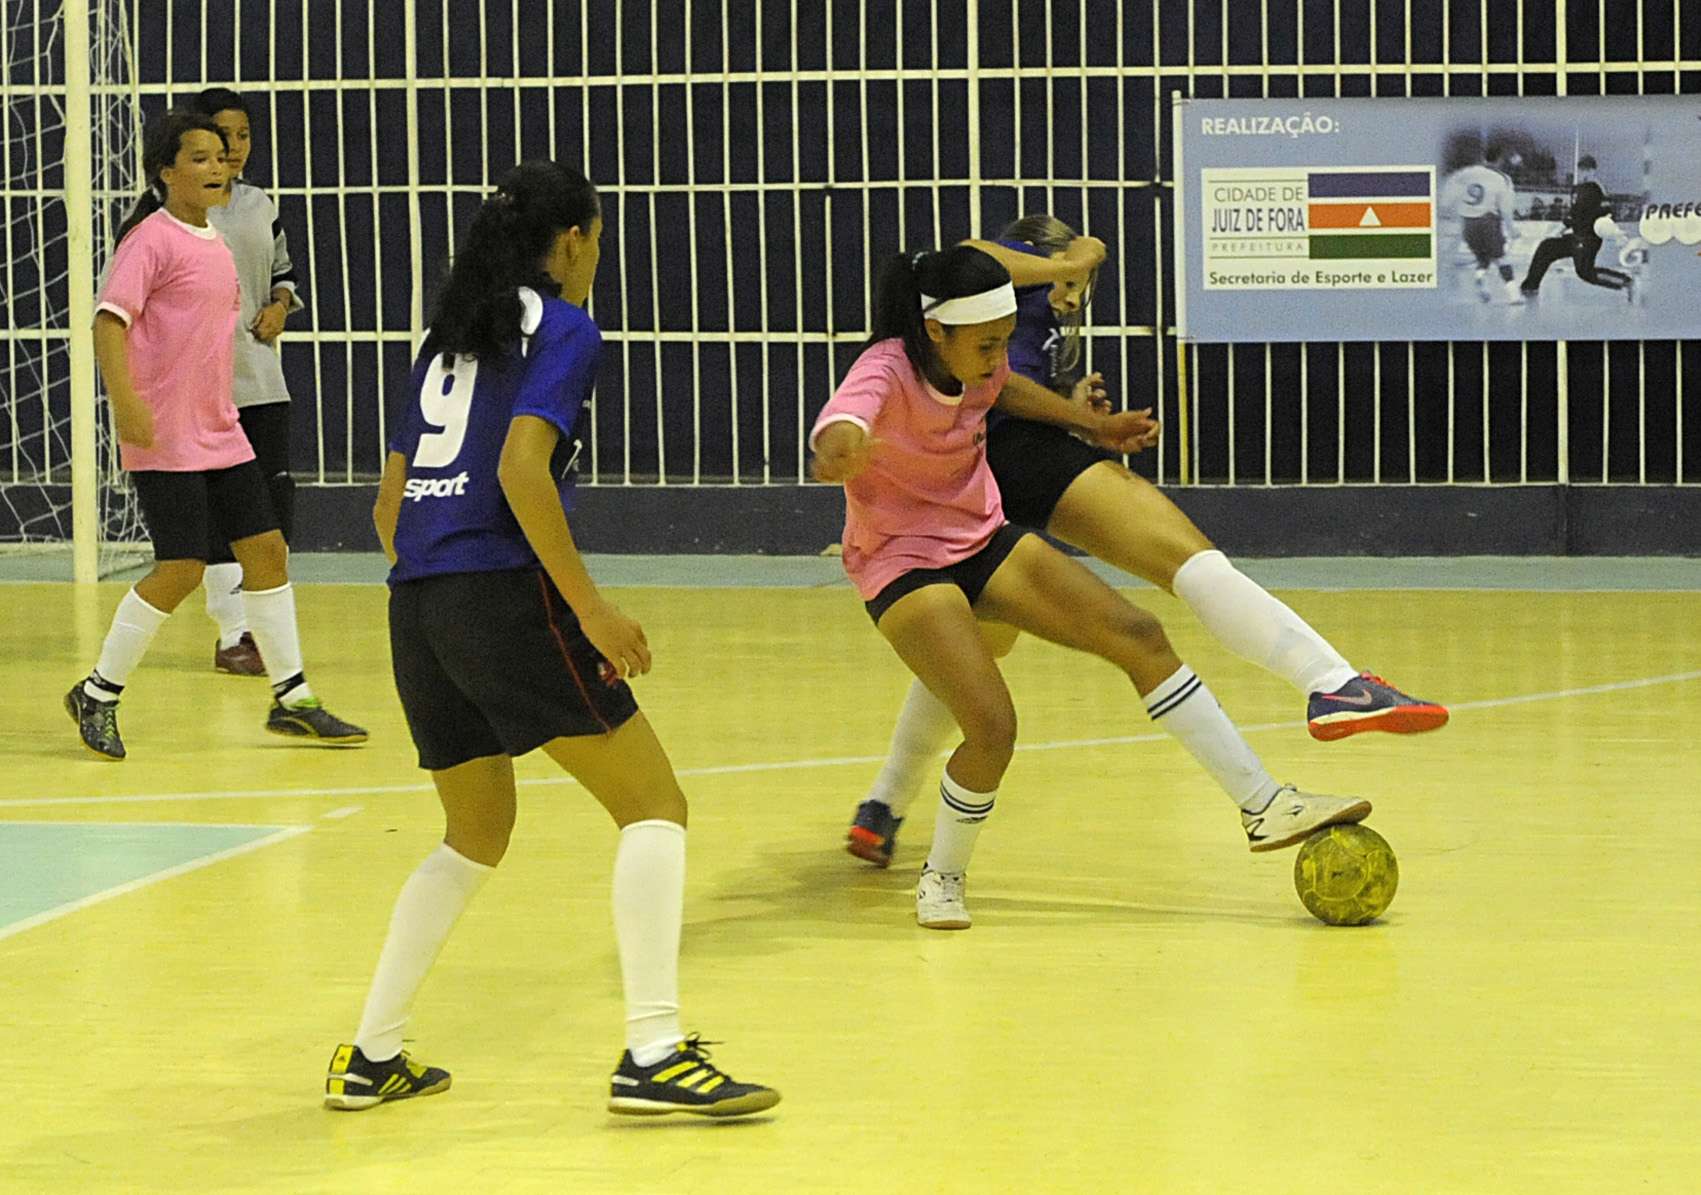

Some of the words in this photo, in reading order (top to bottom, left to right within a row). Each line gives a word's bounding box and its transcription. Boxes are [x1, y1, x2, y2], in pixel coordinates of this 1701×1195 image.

[1201, 112, 1340, 138] REALIZAÇÃO:
[1213, 187, 1276, 203] CIDADE
[1282, 186, 1304, 202] DE
[1211, 208, 1243, 233] JUIZ
[1246, 207, 1263, 232] DE
[1268, 207, 1305, 232] FORA
[1211, 241, 1303, 252] PREFEITURA
[1209, 271, 1286, 285] Secretaria
[1290, 269, 1310, 284] de
[1315, 270, 1372, 287] Esporte
[1377, 273, 1386, 284] e
[1391, 269, 1433, 284] Lazer
[412, 352, 478, 467] 9
[403, 471, 468, 502] sport
